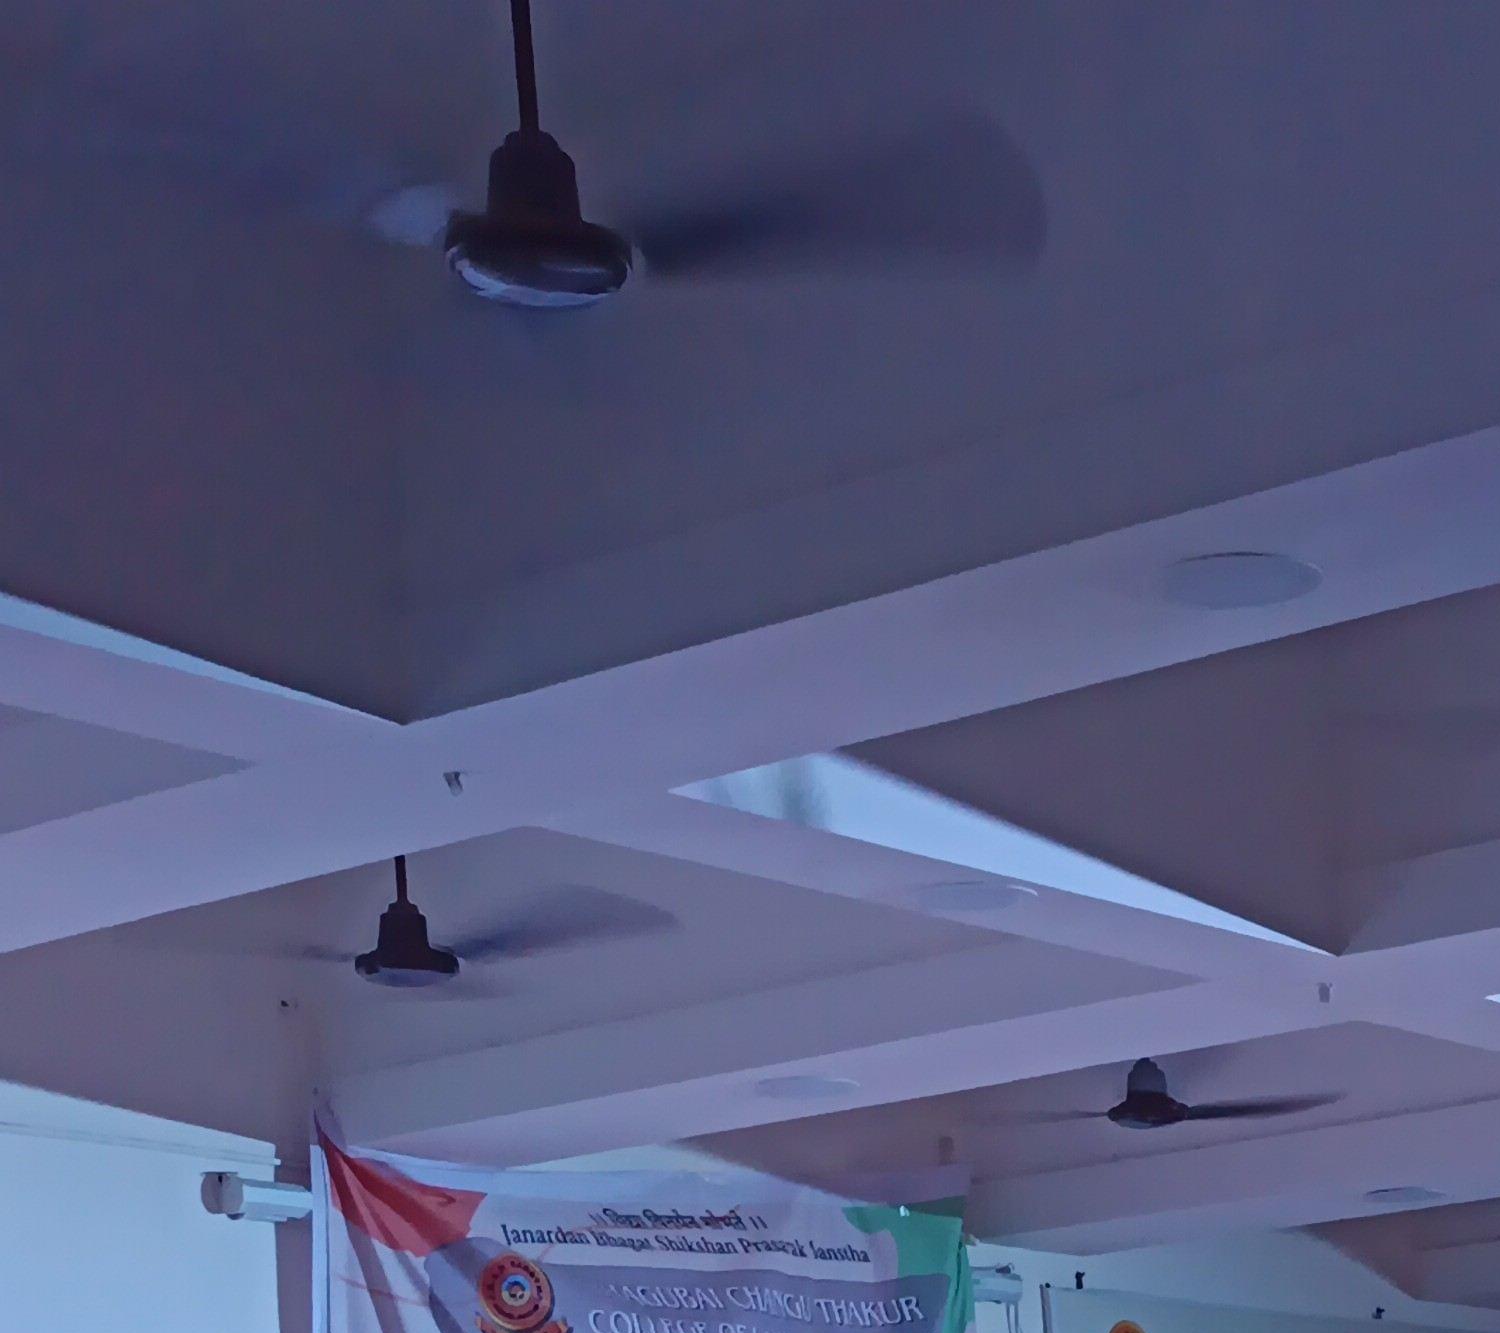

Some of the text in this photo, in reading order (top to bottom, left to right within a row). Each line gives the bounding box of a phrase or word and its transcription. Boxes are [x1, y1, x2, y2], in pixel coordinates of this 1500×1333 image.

[501, 1223, 590, 1246] Janardan
[654, 1235, 738, 1255] Shikshan
[814, 1296, 925, 1327] THAKUR
